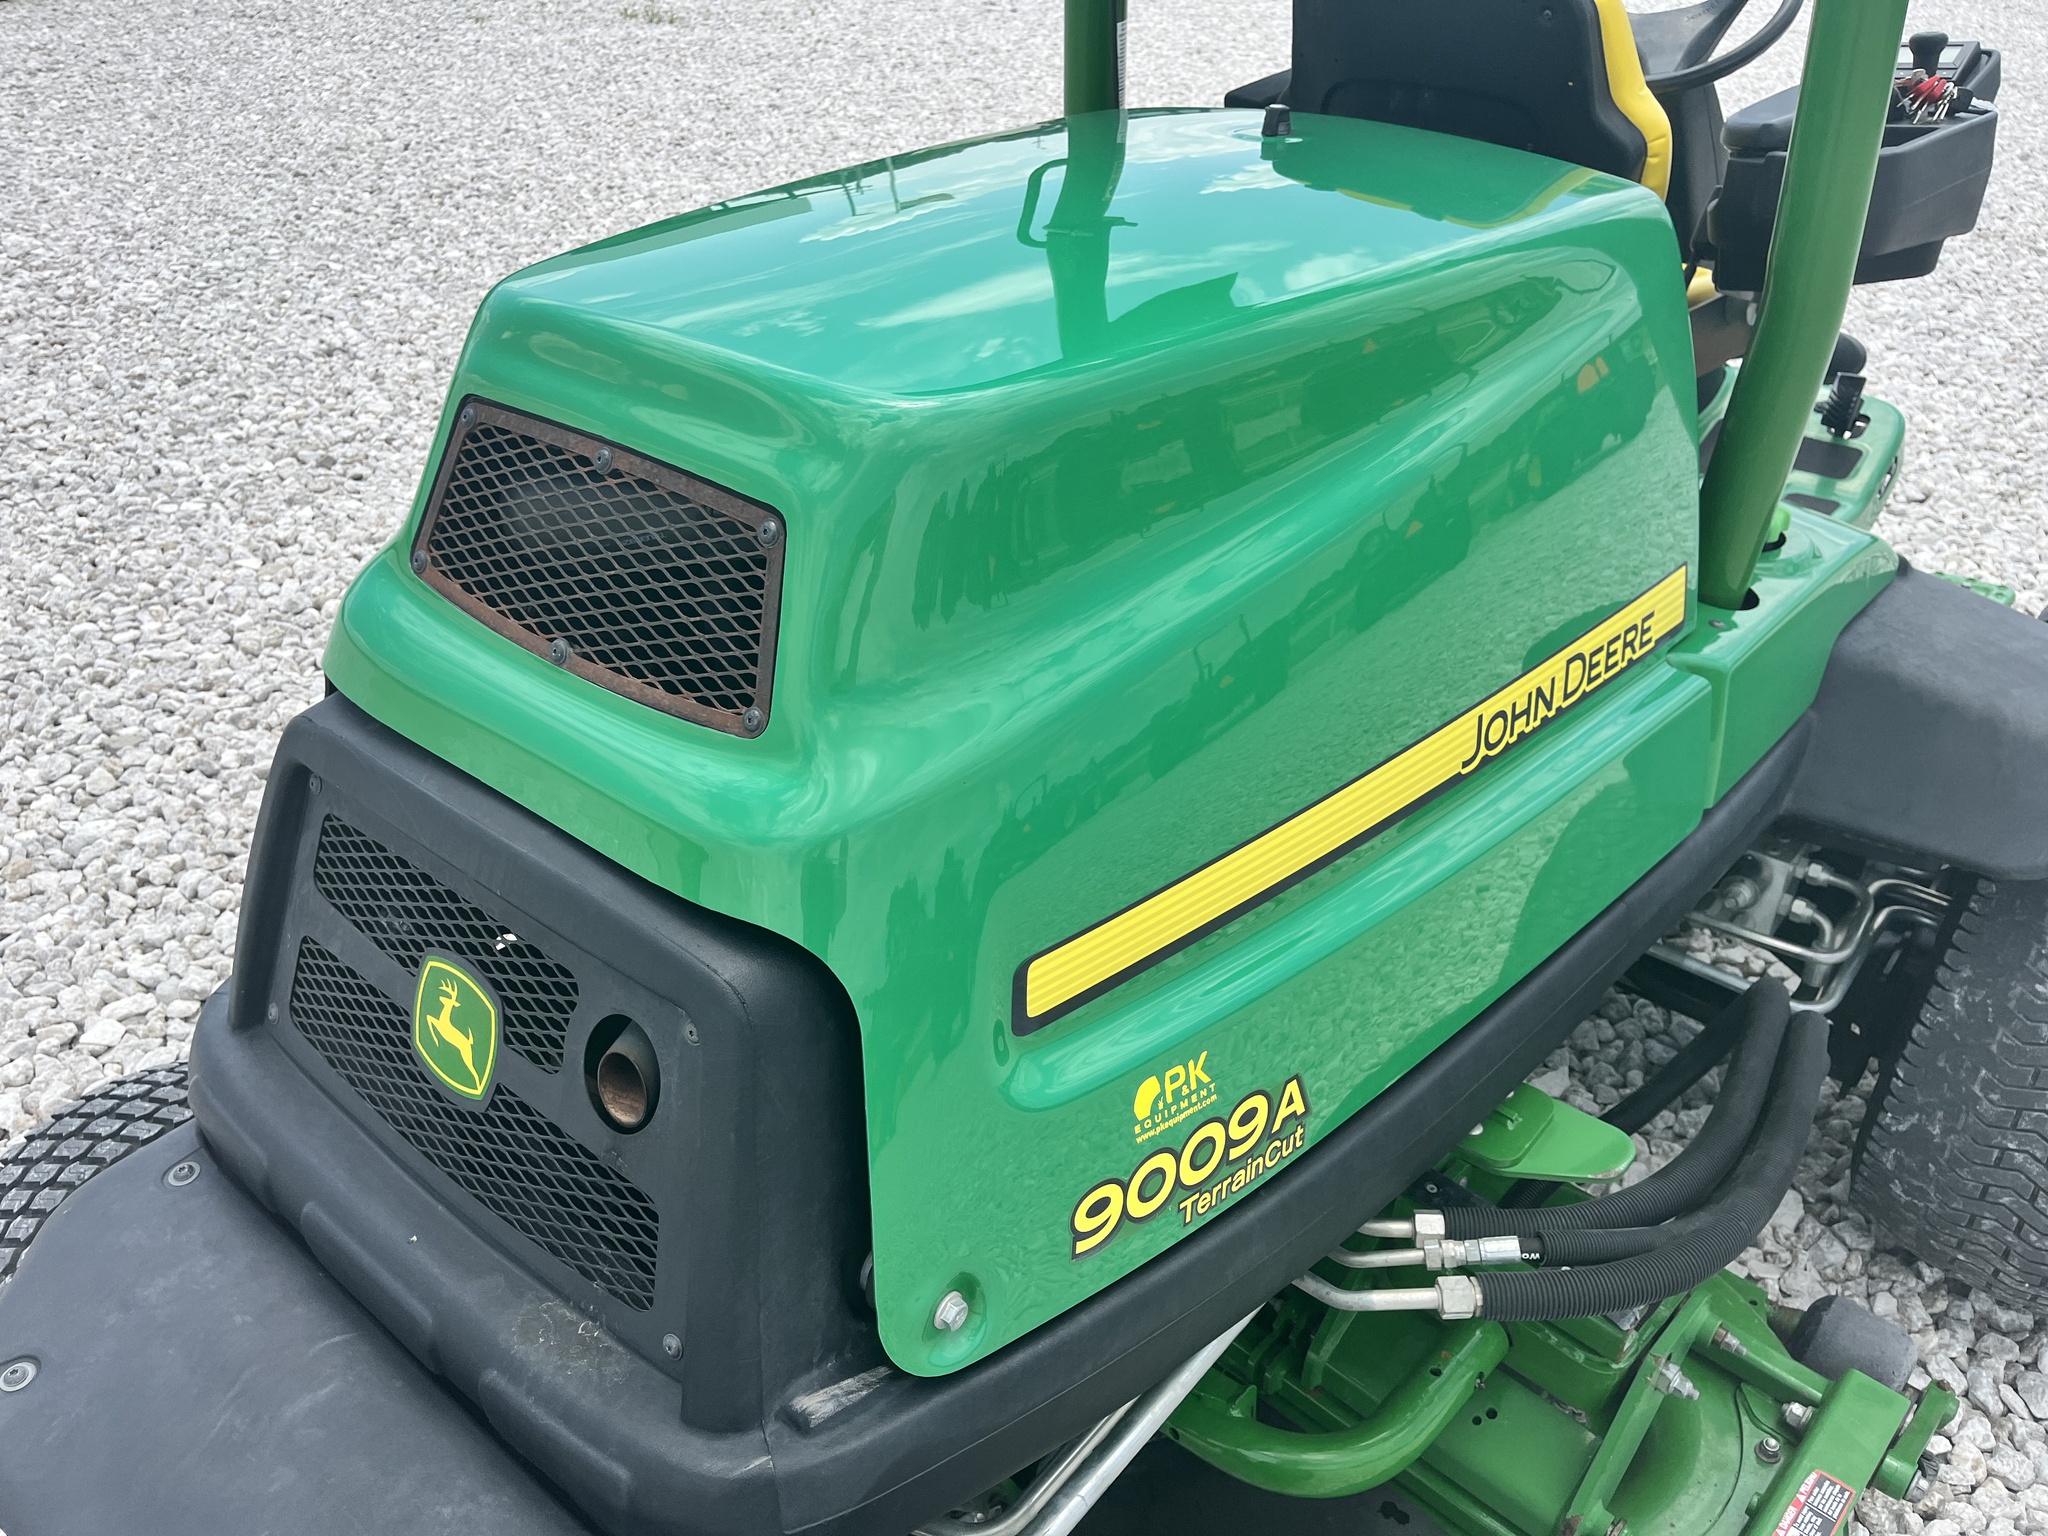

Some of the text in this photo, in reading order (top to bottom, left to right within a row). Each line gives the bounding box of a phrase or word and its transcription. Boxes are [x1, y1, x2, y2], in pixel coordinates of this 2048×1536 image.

[1461, 610, 1656, 773] JOHN DEERE
[1164, 1050, 1212, 1104] P&K
[1134, 1082, 1216, 1135] EQUIPMENT
[1135, 1093, 1218, 1144] www.pkequipment.com
[1071, 1077, 1307, 1257] 9009A
[1178, 1124, 1305, 1225] TerrainCut
[1778, 1505, 1798, 1530] DANGER
